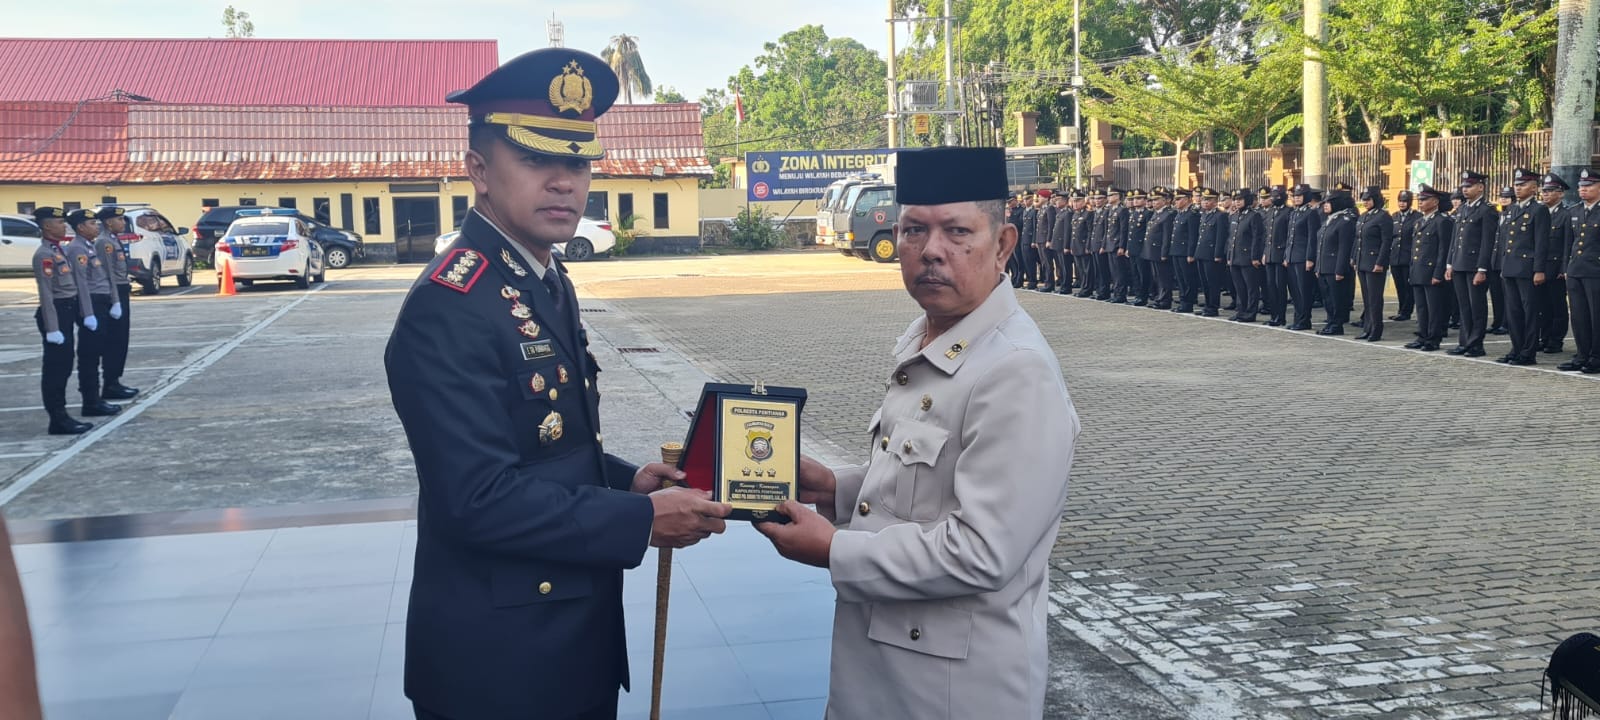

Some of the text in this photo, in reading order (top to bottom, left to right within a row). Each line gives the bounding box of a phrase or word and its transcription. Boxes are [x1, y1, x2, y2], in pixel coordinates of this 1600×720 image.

[779, 154, 888, 171] ZONA INTEGRIT
[779, 172, 804, 180] MENUJU
[772, 187, 798, 195] WILAYAH
